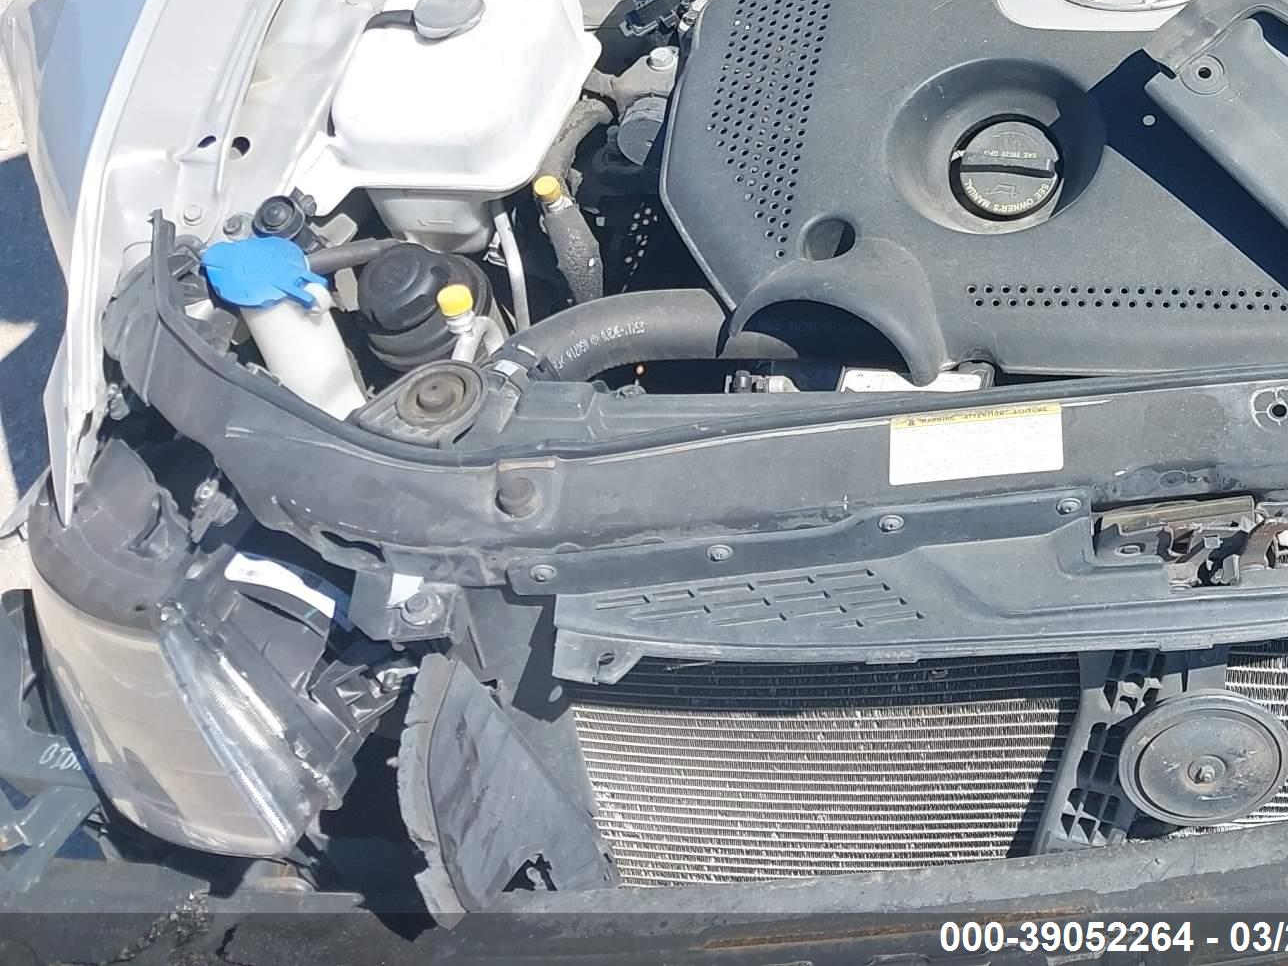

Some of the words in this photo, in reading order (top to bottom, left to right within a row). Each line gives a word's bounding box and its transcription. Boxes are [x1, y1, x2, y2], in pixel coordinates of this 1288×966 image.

[964, 178, 992, 208] MANUAL
[1034, 183, 1049, 200] SEE
[993, 198, 1034, 212] OWNER'S
